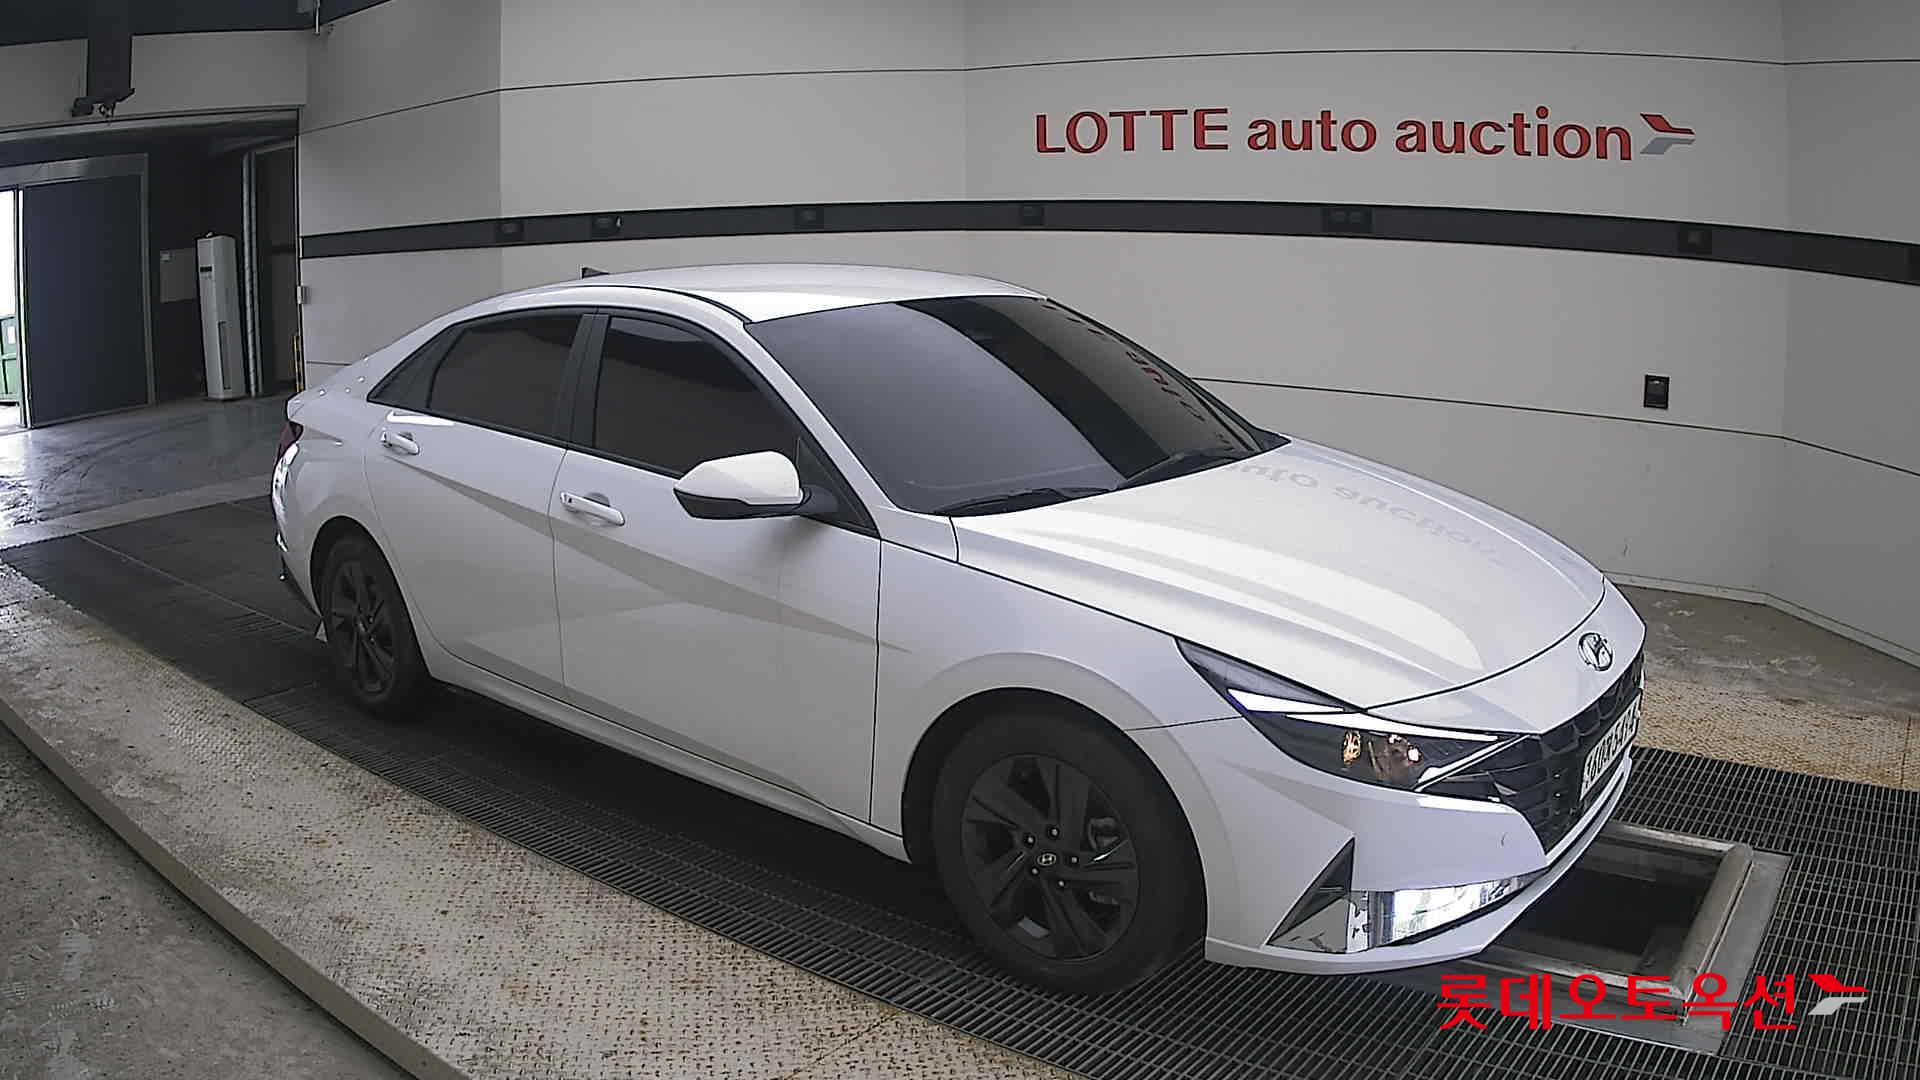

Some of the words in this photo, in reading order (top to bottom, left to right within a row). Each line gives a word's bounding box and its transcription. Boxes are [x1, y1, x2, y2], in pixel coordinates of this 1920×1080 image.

[1035, 107, 1229, 154] LOTTE
[1247, 109, 1377, 153] auto
[1395, 106, 1633, 161] auction
